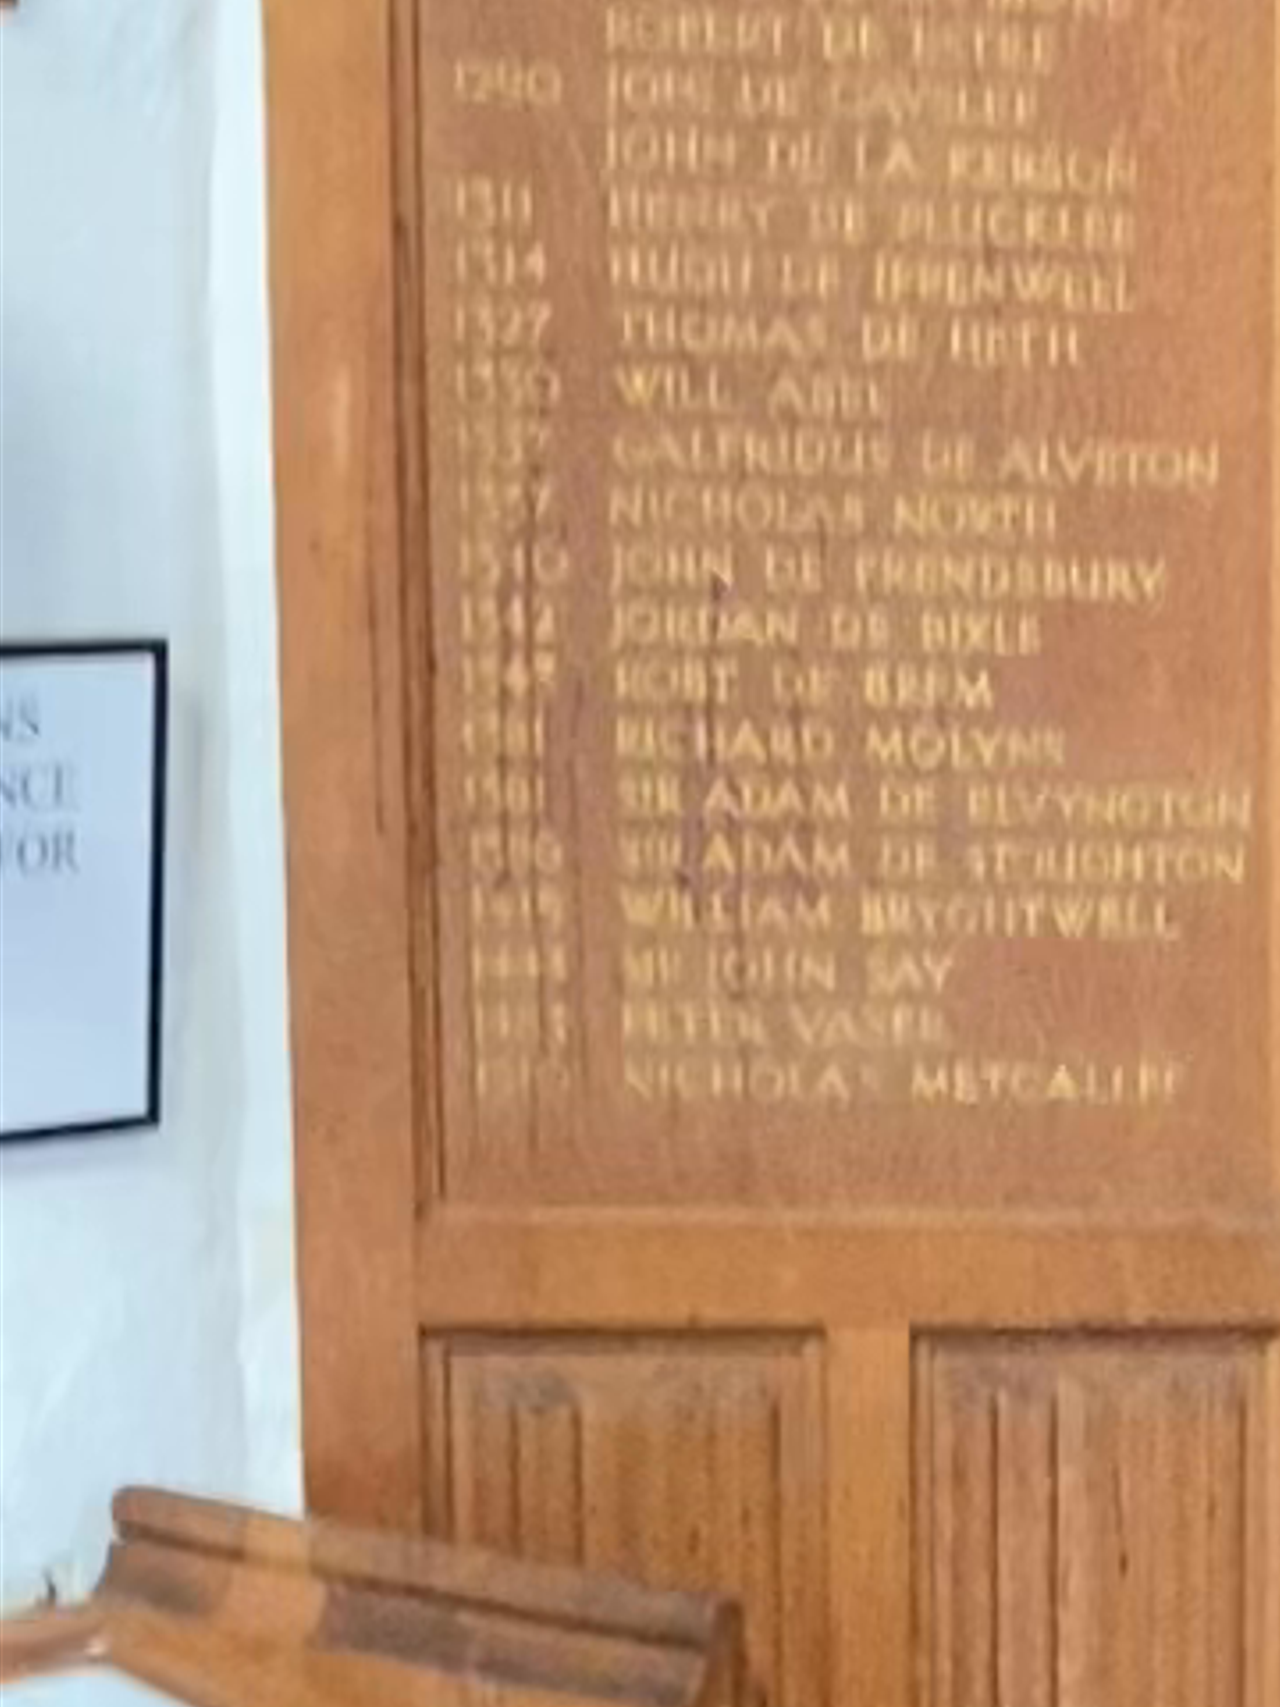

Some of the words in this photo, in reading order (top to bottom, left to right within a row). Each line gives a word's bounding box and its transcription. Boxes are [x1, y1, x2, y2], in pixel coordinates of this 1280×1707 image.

[820, 13, 889, 62] DE
[606, 120, 742, 175] JOHN
[766, 126, 827, 184] DE
[853, 133, 918, 184] LA
[806, 193, 868, 242] DE
[780, 252, 840, 300] DE
[620, 305, 828, 356] THOMAS
[859, 313, 917, 362] DE
[612, 365, 731, 413] WILL
[920, 430, 977, 475] DE
[609, 483, 862, 534] NICHOLAS
[893, 491, 1058, 539] NORTH
[608, 539, 736, 595] JOHN
[763, 545, 821, 593] DE
[608, 598, 800, 651] JORDAN
[829, 604, 890, 651] DE
[771, 658, 836, 705] DE
[614, 714, 836, 764] RICHARD
[701, 775, 851, 823] ADAM
[876, 779, 936, 821] DE
[0, 825, 81, 879] OR
[701, 833, 851, 877] ADAM
[876, 836, 938, 880] DE
[619, 886, 832, 935] WILLIAM
[709, 945, 837, 995] JOHN
[865, 948, 955, 995] SAY
[620, 1057, 875, 1104] NICHOLAS
